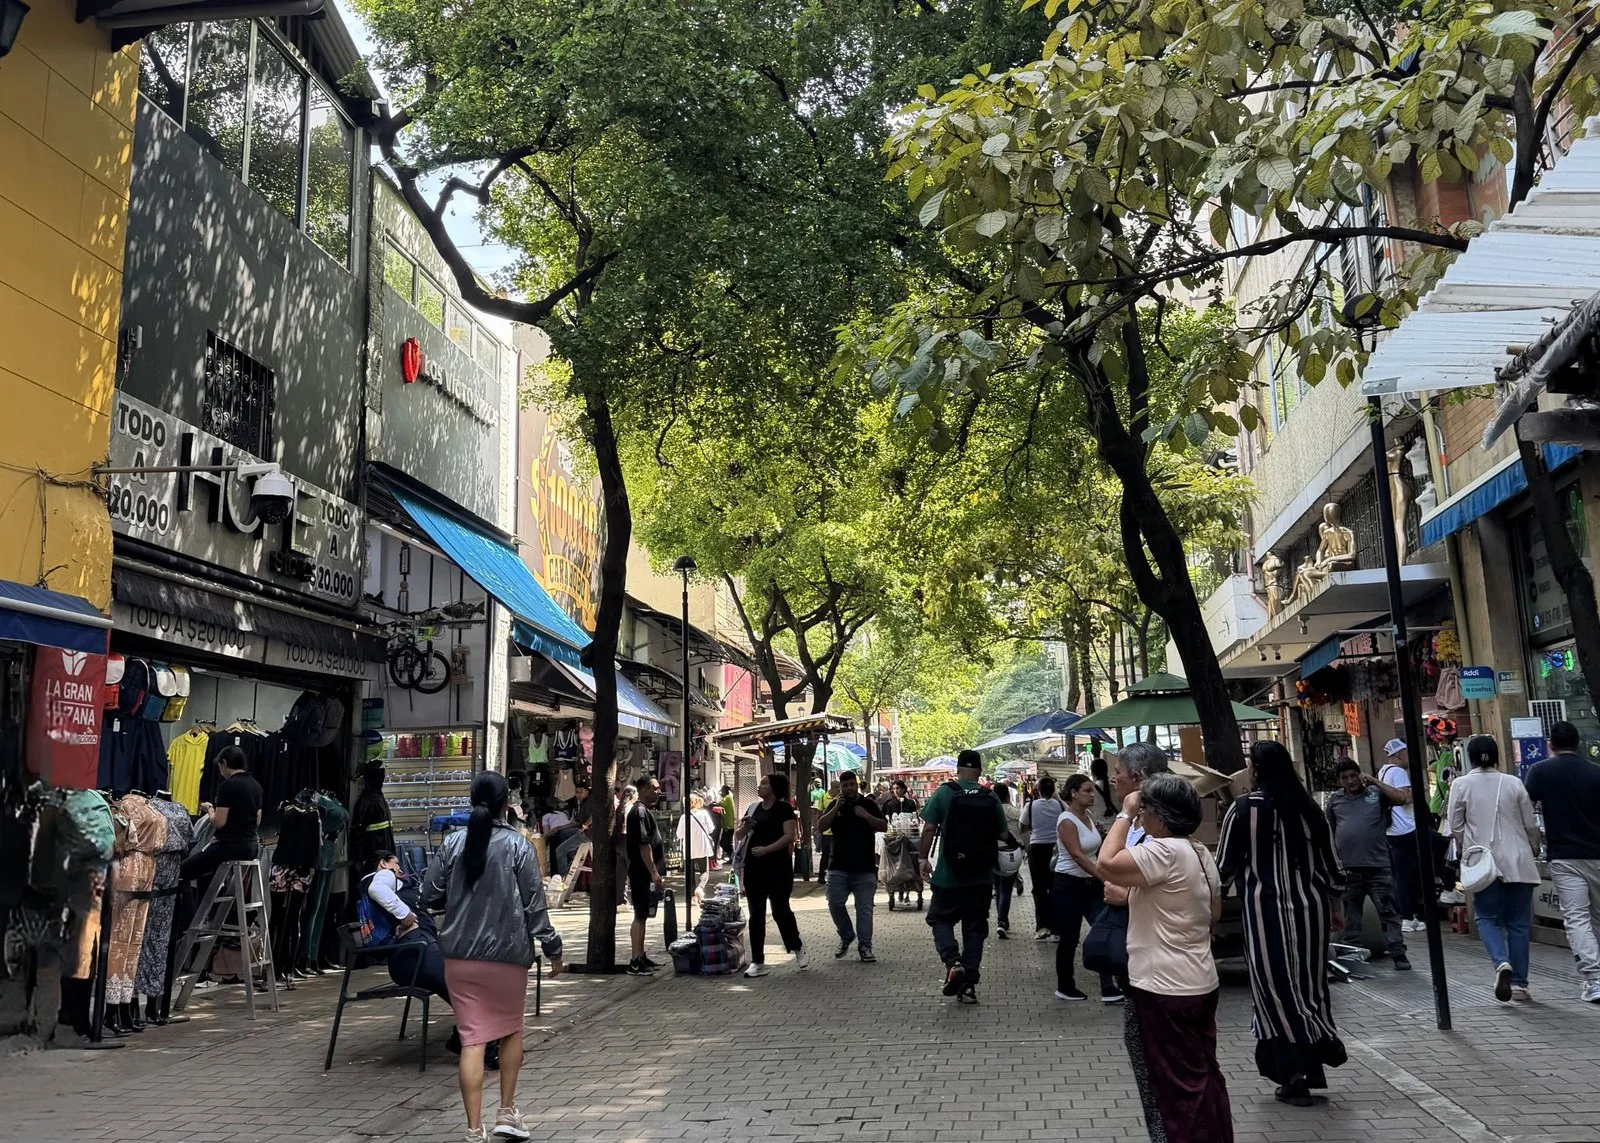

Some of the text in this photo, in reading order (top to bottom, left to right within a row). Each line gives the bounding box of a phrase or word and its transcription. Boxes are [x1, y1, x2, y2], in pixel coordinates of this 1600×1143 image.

[119, 402, 165, 447] TODO
[132, 451, 146, 480] A
[321, 498, 350, 530] TODO
[330, 534, 338, 556] A
[129, 605, 246, 650] TODO A $20000
[285, 642, 315, 664] TODO
[315, 650, 324, 667] A
[46, 679, 93, 702] LA GRAN
